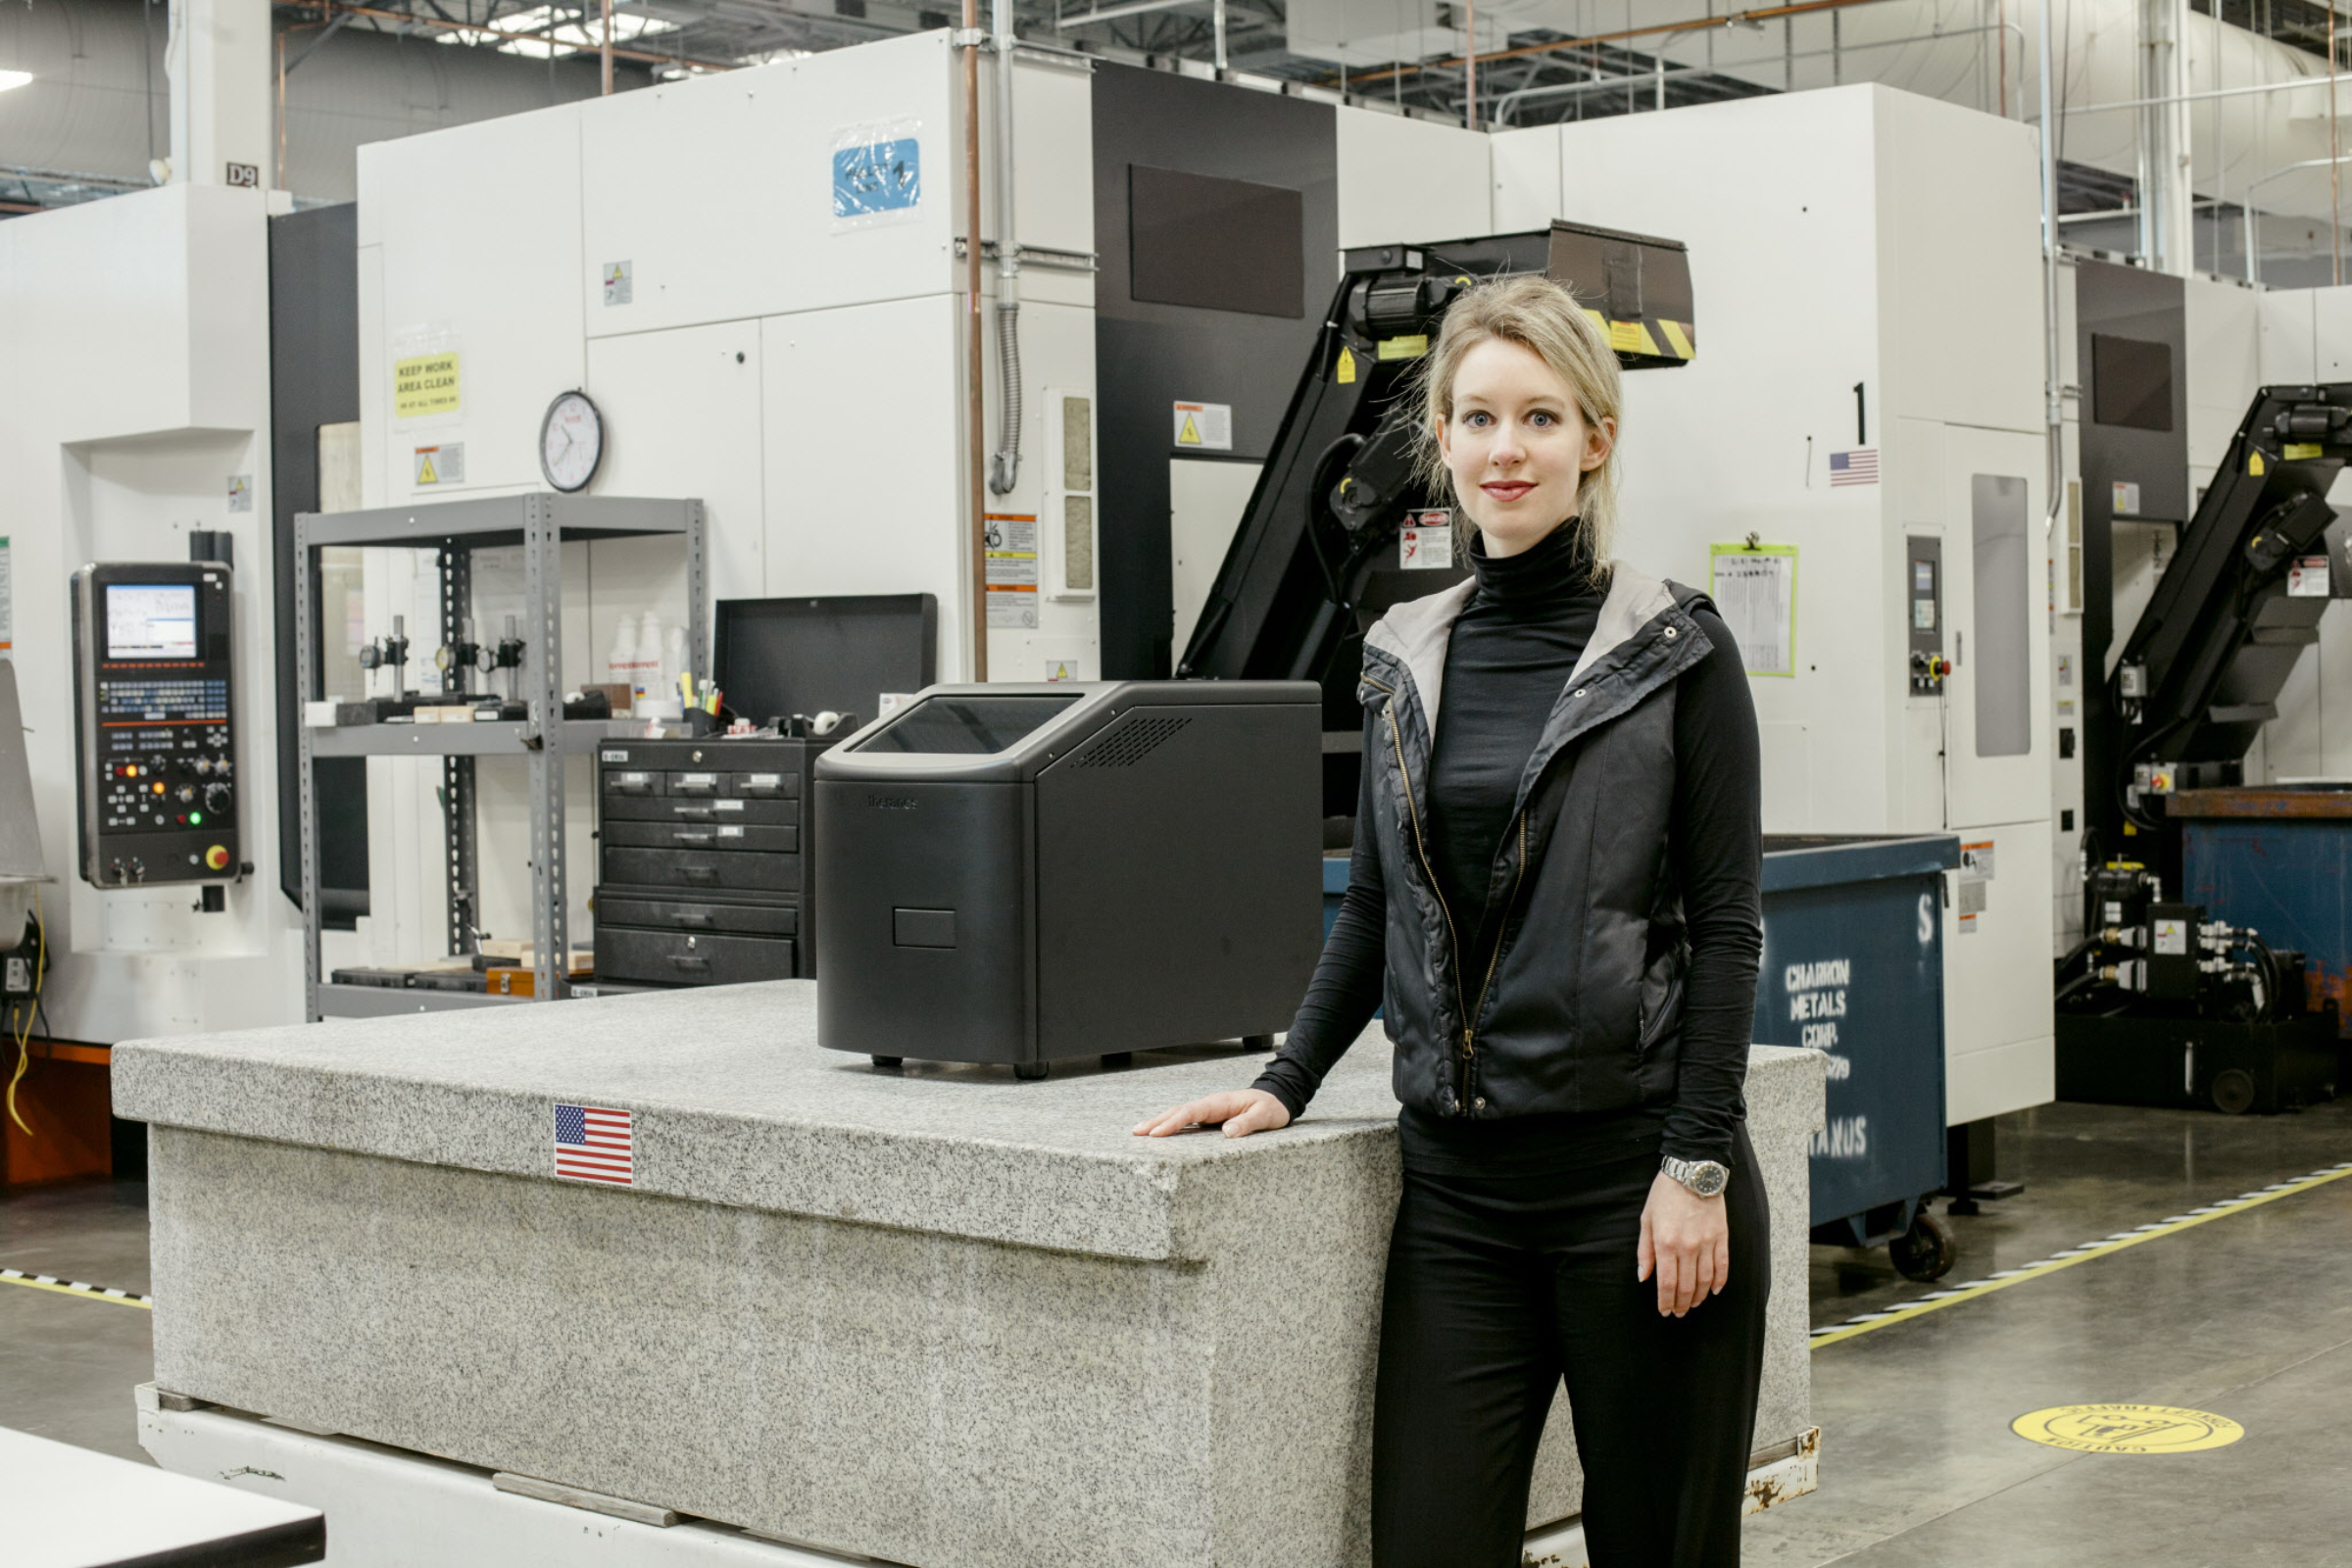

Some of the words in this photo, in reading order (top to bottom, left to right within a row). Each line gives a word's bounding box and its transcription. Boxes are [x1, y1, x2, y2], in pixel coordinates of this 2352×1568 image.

[228, 165, 256, 186] D9
[893, 160, 906, 188] 1
[399, 366, 422, 377] KEEP
[425, 360, 453, 373] WORK
[398, 380, 421, 393] AREA
[424, 376, 455, 390] CLEAN
[1853, 381, 1866, 445] 1
[1918, 893, 1933, 945] S
[1786, 958, 1850, 993] CHARRON
[1789, 990, 1846, 1021] METALS
[2042, 1438, 2147, 1452] CAUTION
